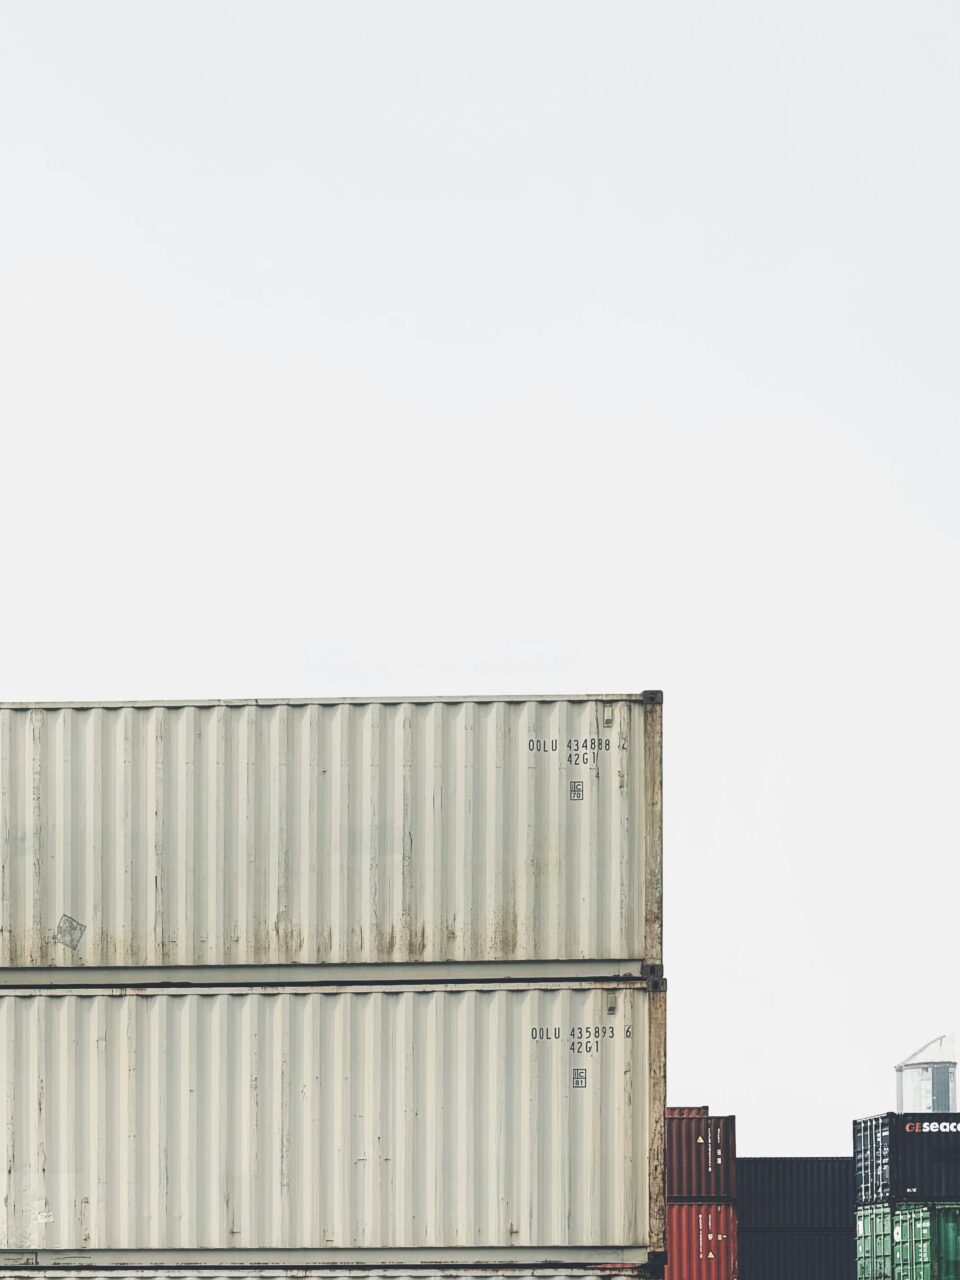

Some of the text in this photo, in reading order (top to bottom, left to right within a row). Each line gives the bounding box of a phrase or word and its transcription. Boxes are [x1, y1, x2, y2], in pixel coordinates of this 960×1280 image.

[566, 738, 611, 752] 434888
[566, 752, 596, 765] 42G1
[569, 1026, 615, 1039] 435893
[625, 1027, 632, 1038] 6
[569, 1040, 599, 1053] 42G1
